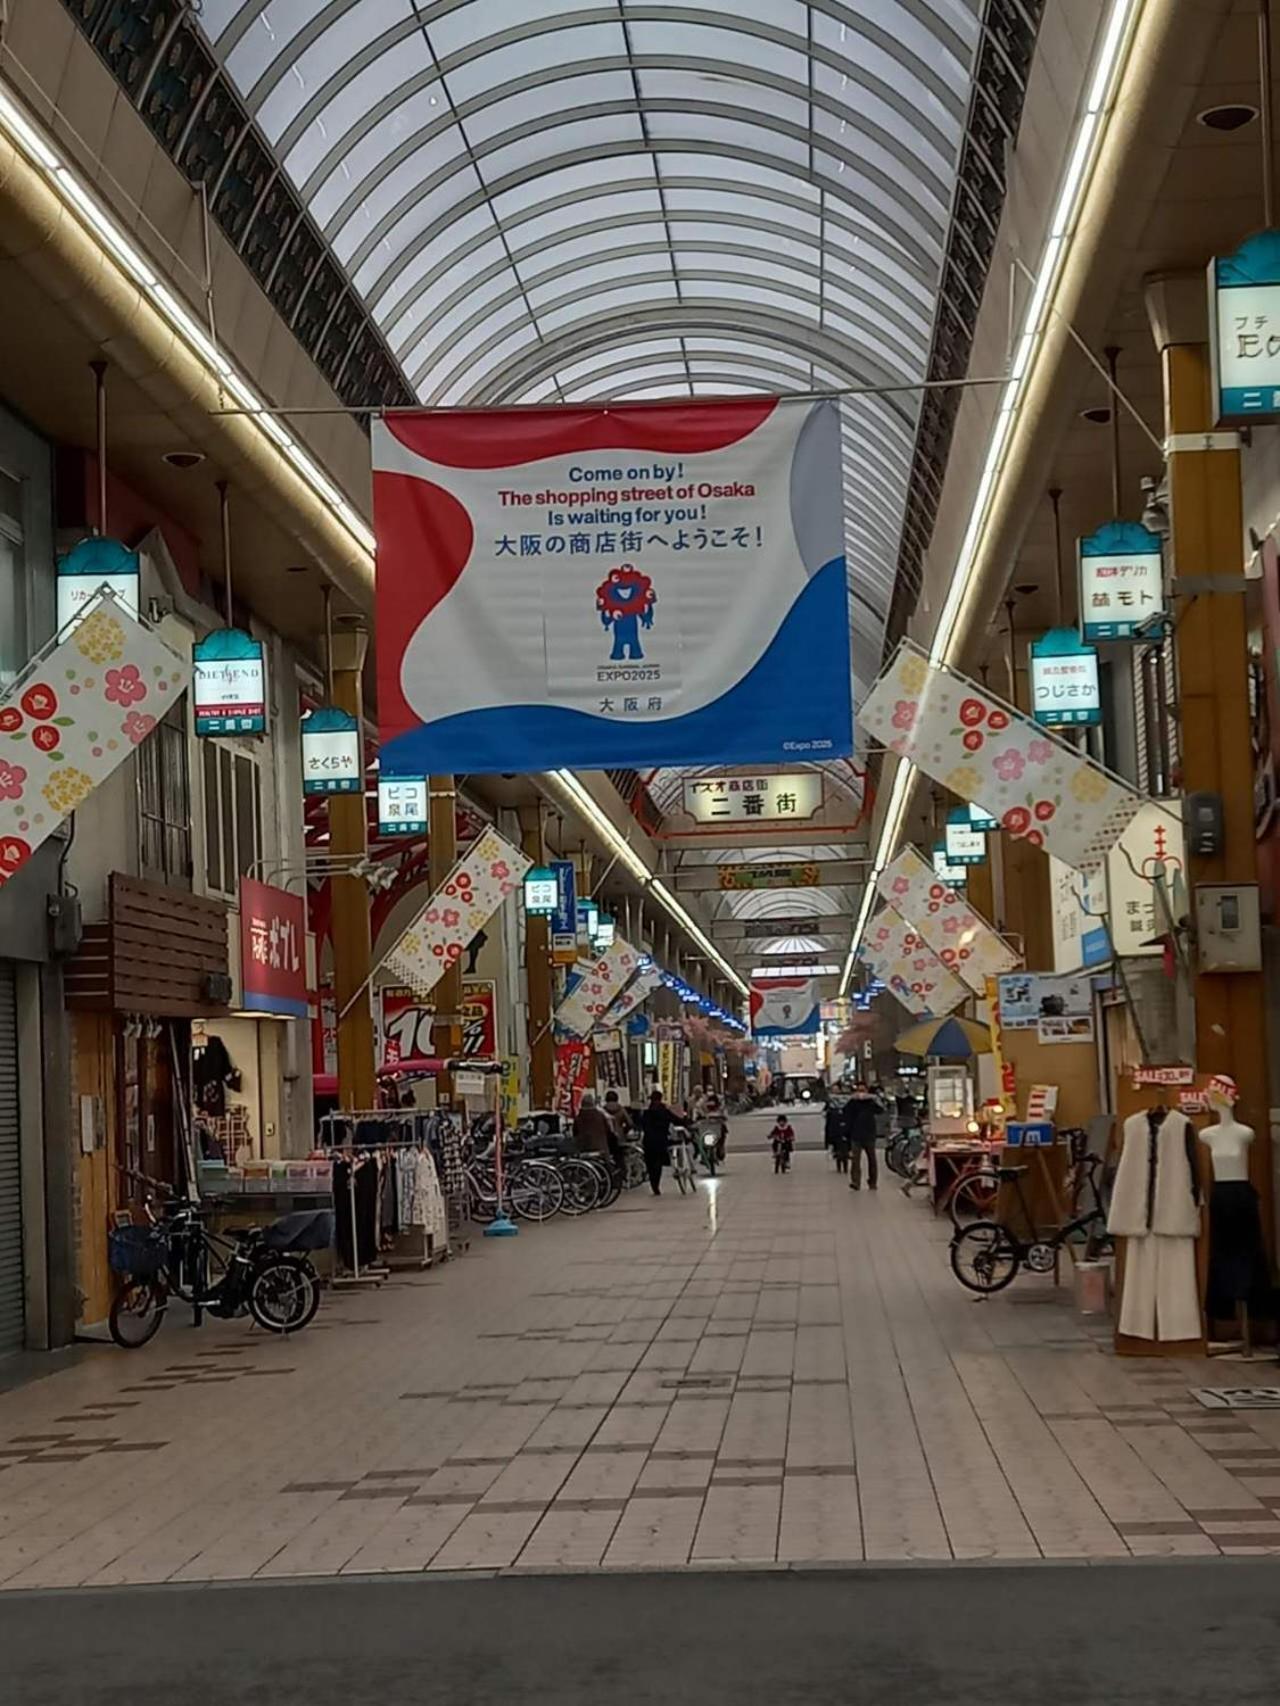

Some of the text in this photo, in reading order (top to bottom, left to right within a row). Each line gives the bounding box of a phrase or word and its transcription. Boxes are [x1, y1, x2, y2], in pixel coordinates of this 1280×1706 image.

[568, 463, 684, 482] Come on by!
[498, 482, 755, 508] The shopping street of Osaka
[548, 505, 706, 527] Is waiting for you!
[597, 670, 661, 682] EXPO2025
[599, 696, 662, 713] 大阪府
[308, 755, 353, 770] さくらや
[711, 792, 798, 817] 二番街
